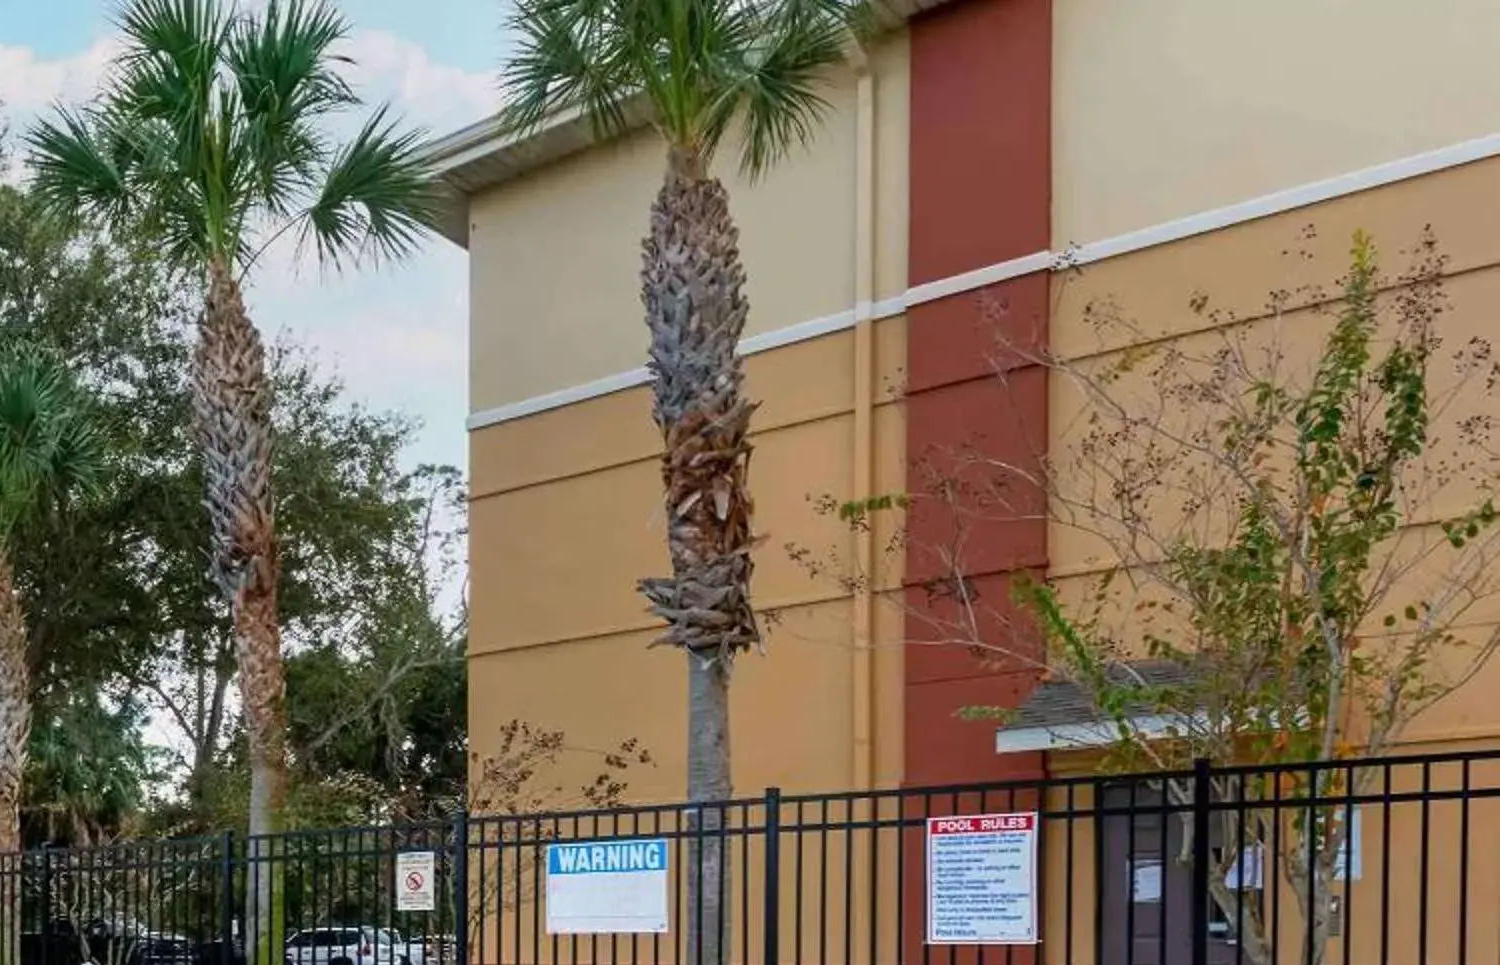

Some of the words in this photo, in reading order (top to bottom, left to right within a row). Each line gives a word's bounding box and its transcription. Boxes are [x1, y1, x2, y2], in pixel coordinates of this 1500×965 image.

[938, 820, 975, 832] POOL
[981, 817, 1027, 830] RULES
[558, 844, 660, 872] WARNING
